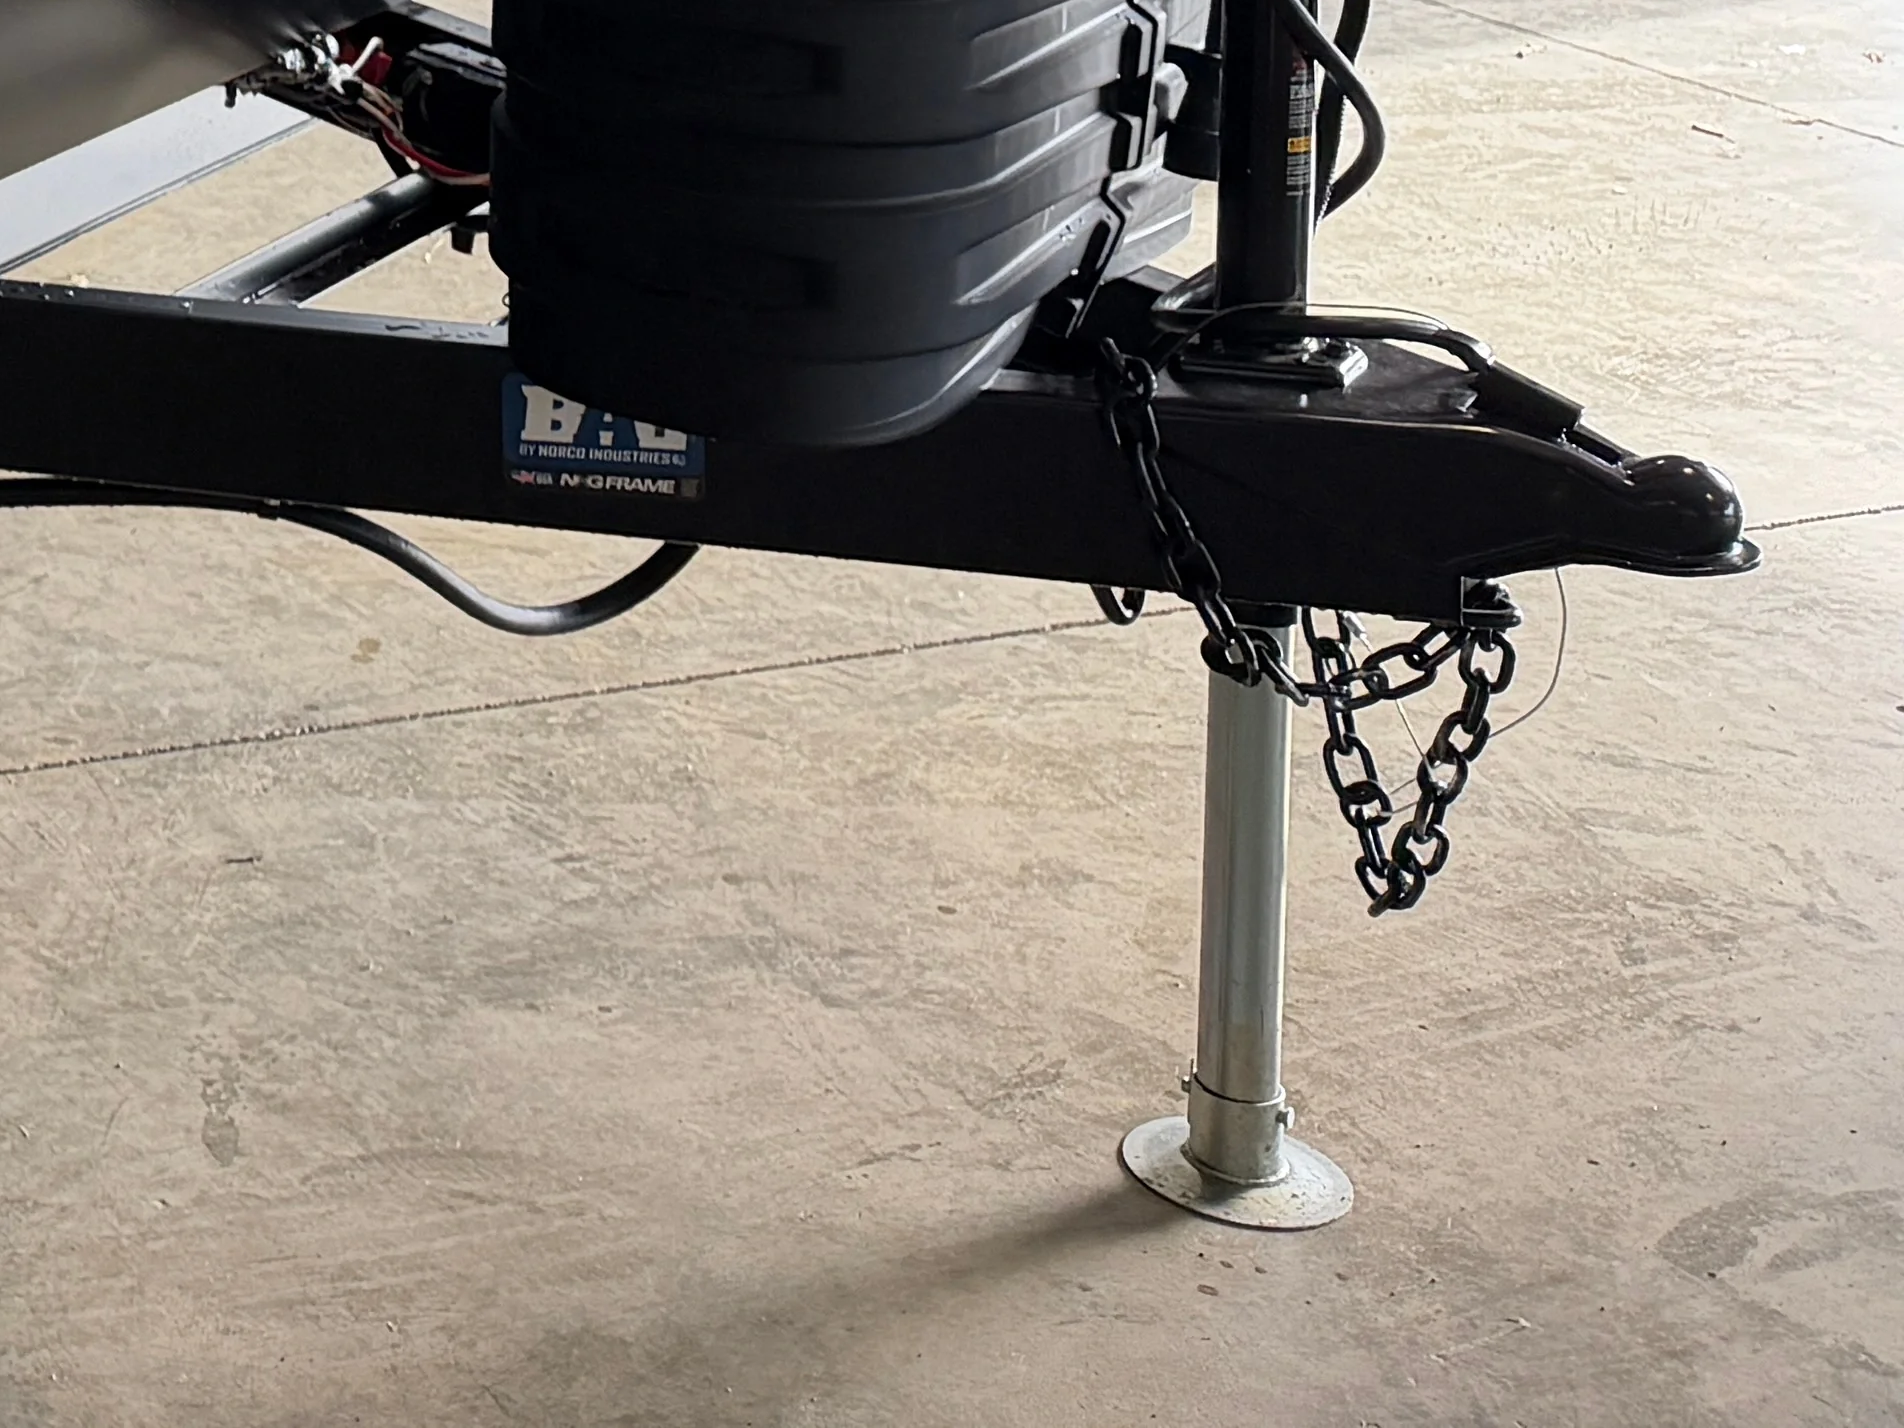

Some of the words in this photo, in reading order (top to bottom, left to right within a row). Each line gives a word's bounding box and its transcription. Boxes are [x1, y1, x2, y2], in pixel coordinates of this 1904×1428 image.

[519, 442, 535, 456] BY
[538, 444, 586, 460] NORCO
[589, 448, 671, 465] INDUSTRIES
